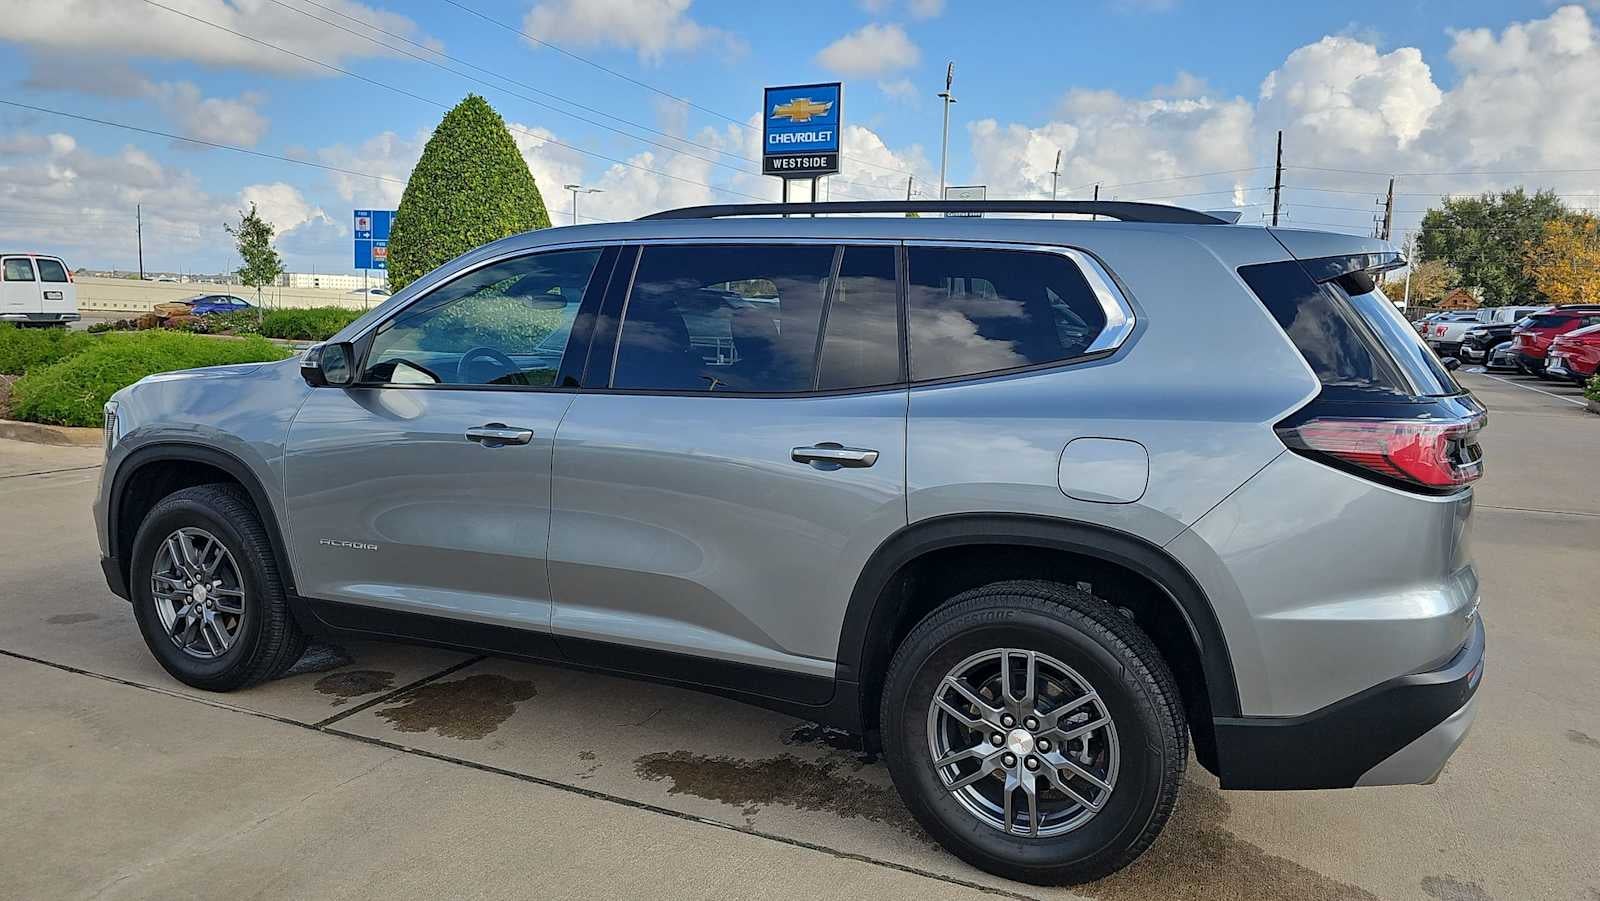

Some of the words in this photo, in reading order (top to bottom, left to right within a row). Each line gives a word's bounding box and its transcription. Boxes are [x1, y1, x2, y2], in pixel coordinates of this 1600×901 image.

[769, 131, 832, 144] CHEVROLET
[773, 157, 828, 169] WESTSIDE
[319, 538, 378, 551] ACADIA
